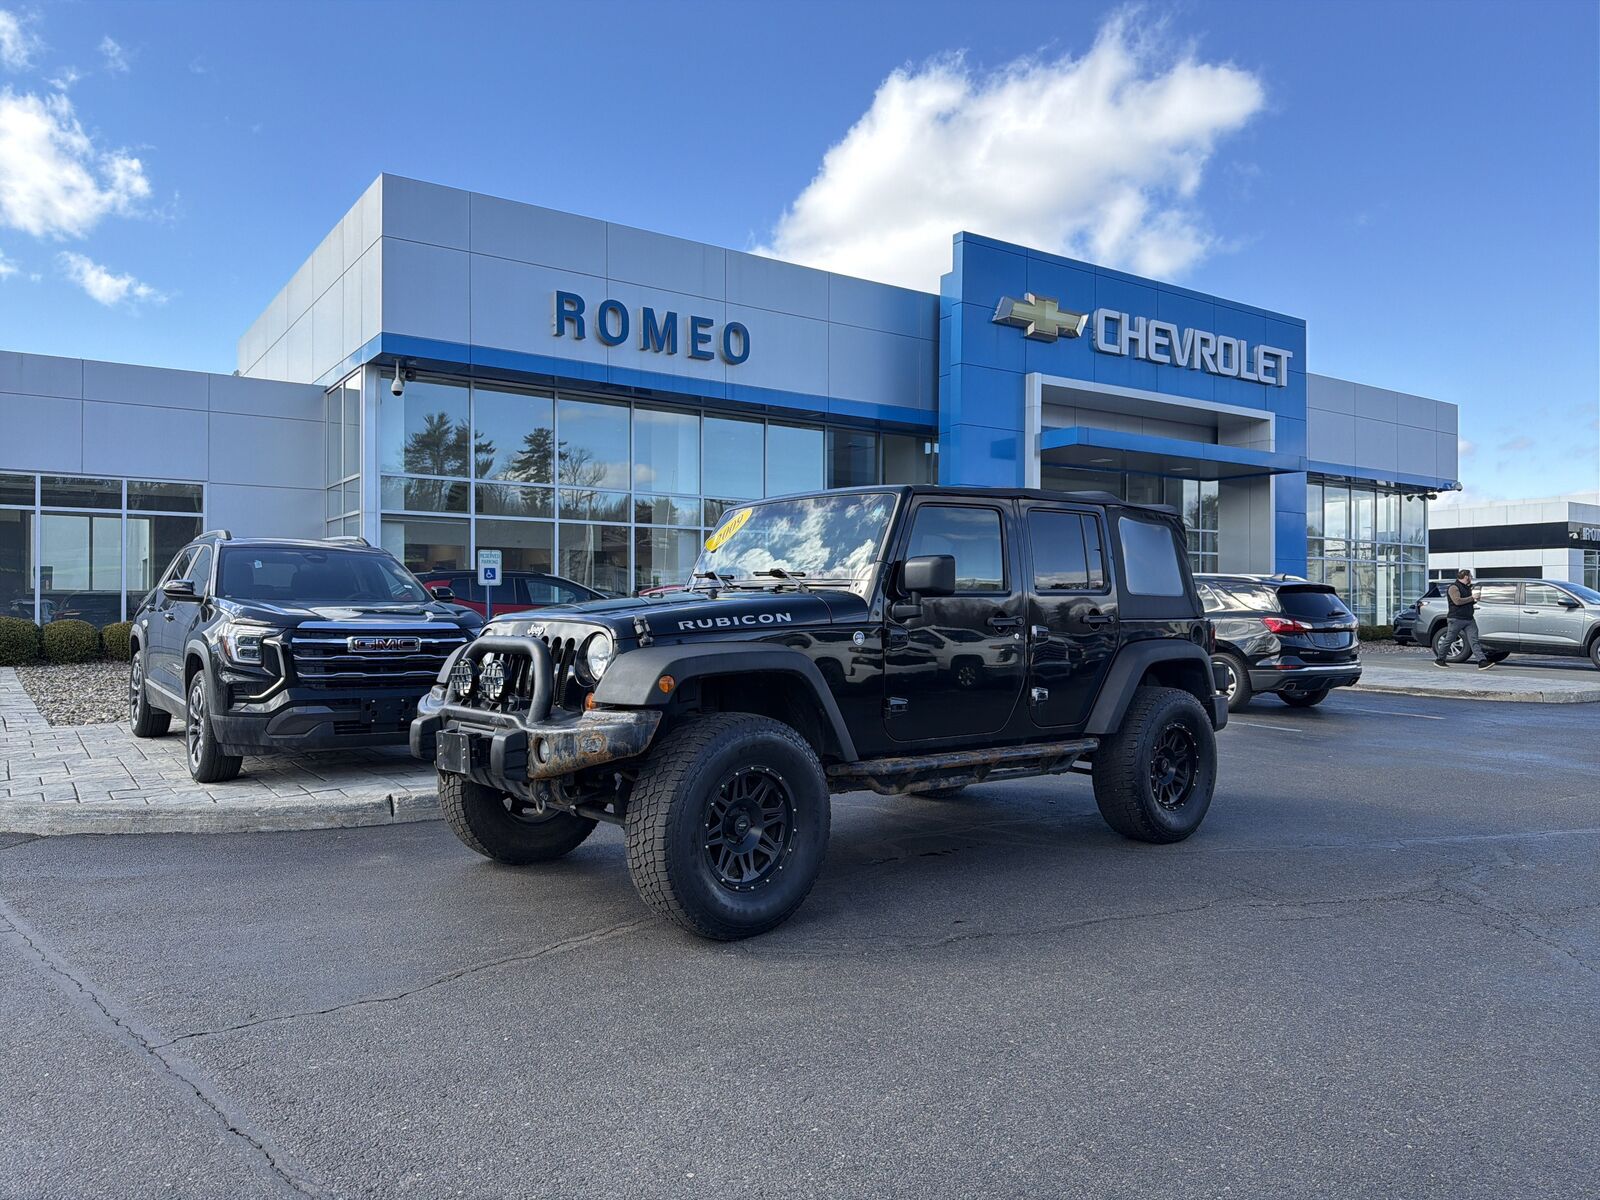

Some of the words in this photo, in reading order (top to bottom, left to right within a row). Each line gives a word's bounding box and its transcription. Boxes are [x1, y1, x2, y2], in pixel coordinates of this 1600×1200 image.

[553, 290, 750, 365] ROMEO
[1093, 307, 1293, 387] CHEVROLET
[678, 612, 792, 630] RUBICON
[527, 624, 545, 637] Jeep
[354, 638, 418, 651] GMC
